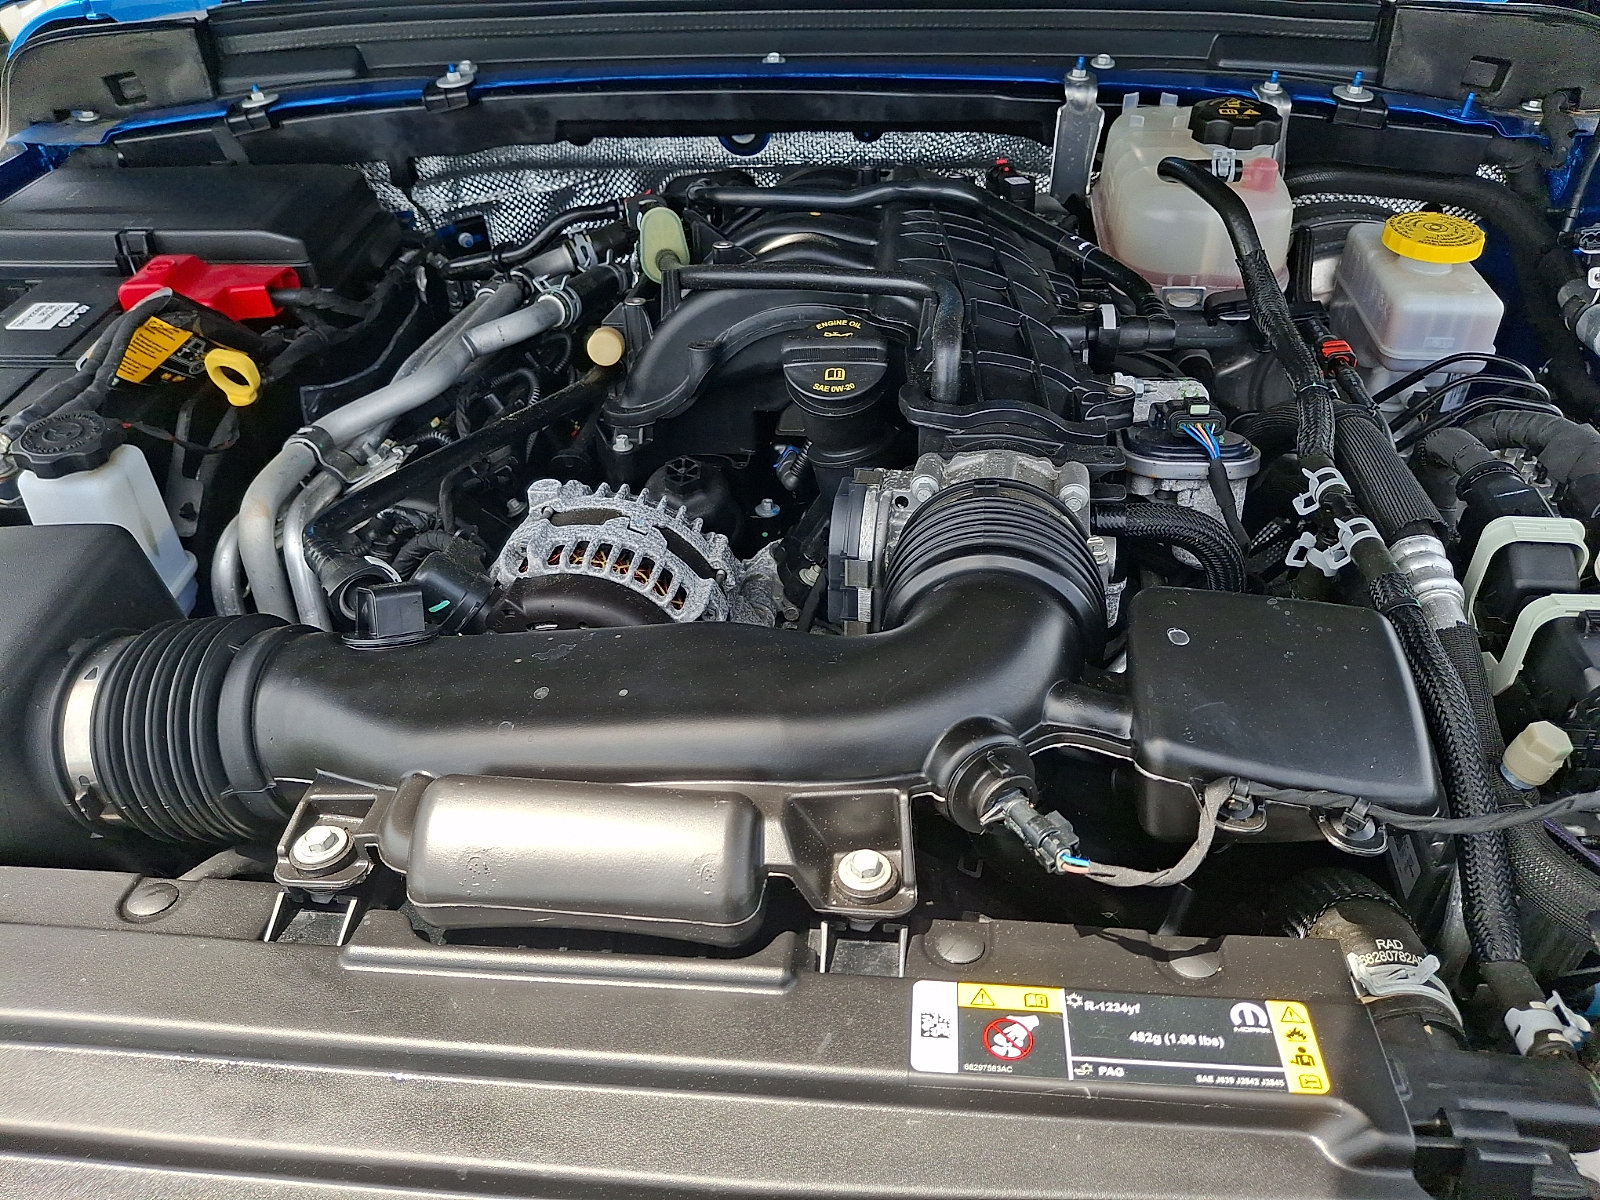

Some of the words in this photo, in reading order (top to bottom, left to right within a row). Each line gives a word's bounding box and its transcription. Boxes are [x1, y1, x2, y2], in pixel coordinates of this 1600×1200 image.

[816, 320, 848, 330] ENGINE
[849, 321, 862, 330] OIL
[812, 383, 830, 392] SAE
[831, 383, 855, 393] 0W-20
[1375, 939, 1404, 950] RAD
[1084, 1001, 1141, 1015] R-1234yf
[1198, 1035, 1225, 1049] lbs)
[1098, 1066, 1125, 1077] PAG
